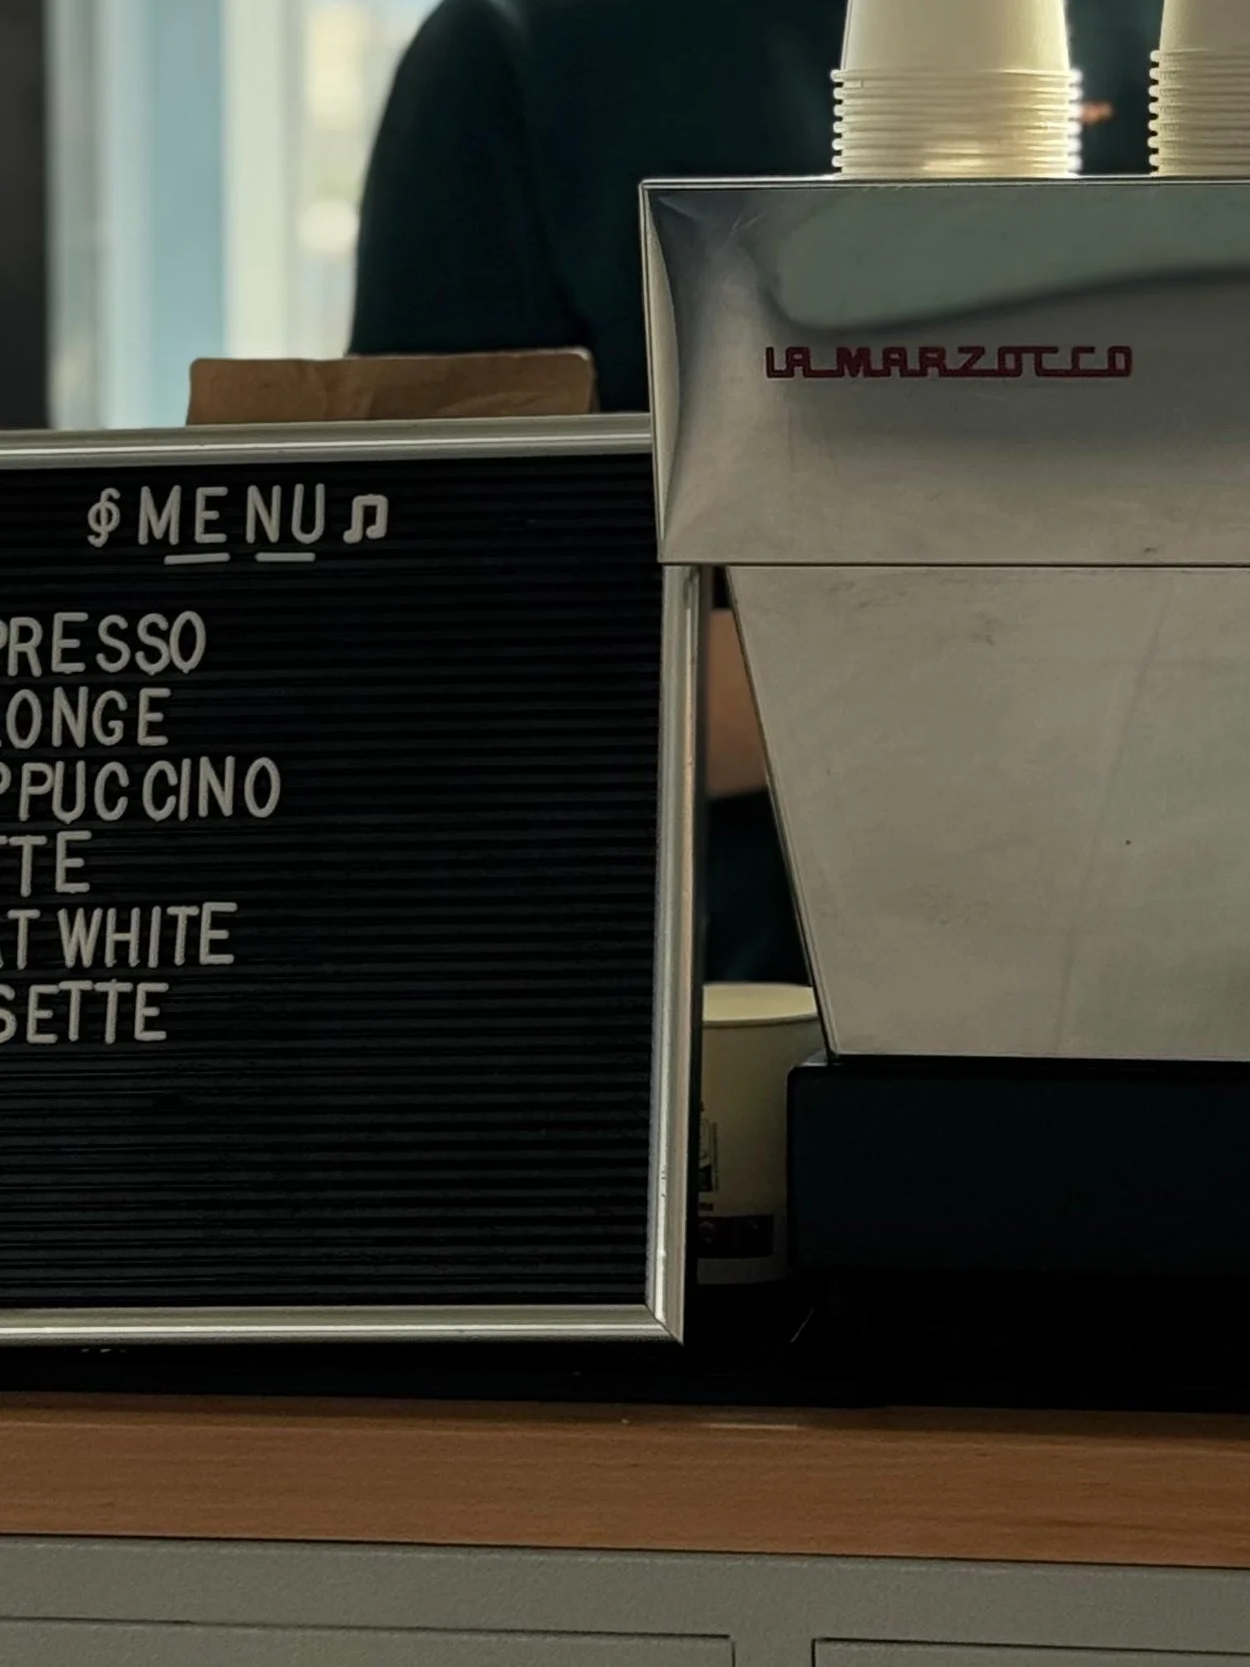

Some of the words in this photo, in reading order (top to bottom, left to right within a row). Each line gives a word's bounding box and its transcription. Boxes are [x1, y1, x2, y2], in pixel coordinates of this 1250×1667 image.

[765, 346, 808, 378] LA
[137, 482, 326, 546] MENU
[0, 609, 207, 678] RESSO
[0, 685, 172, 750] ONGE
[0, 830, 92, 897] TE
[0, 909, 41, 970] T
[57, 901, 239, 969] WHITE
